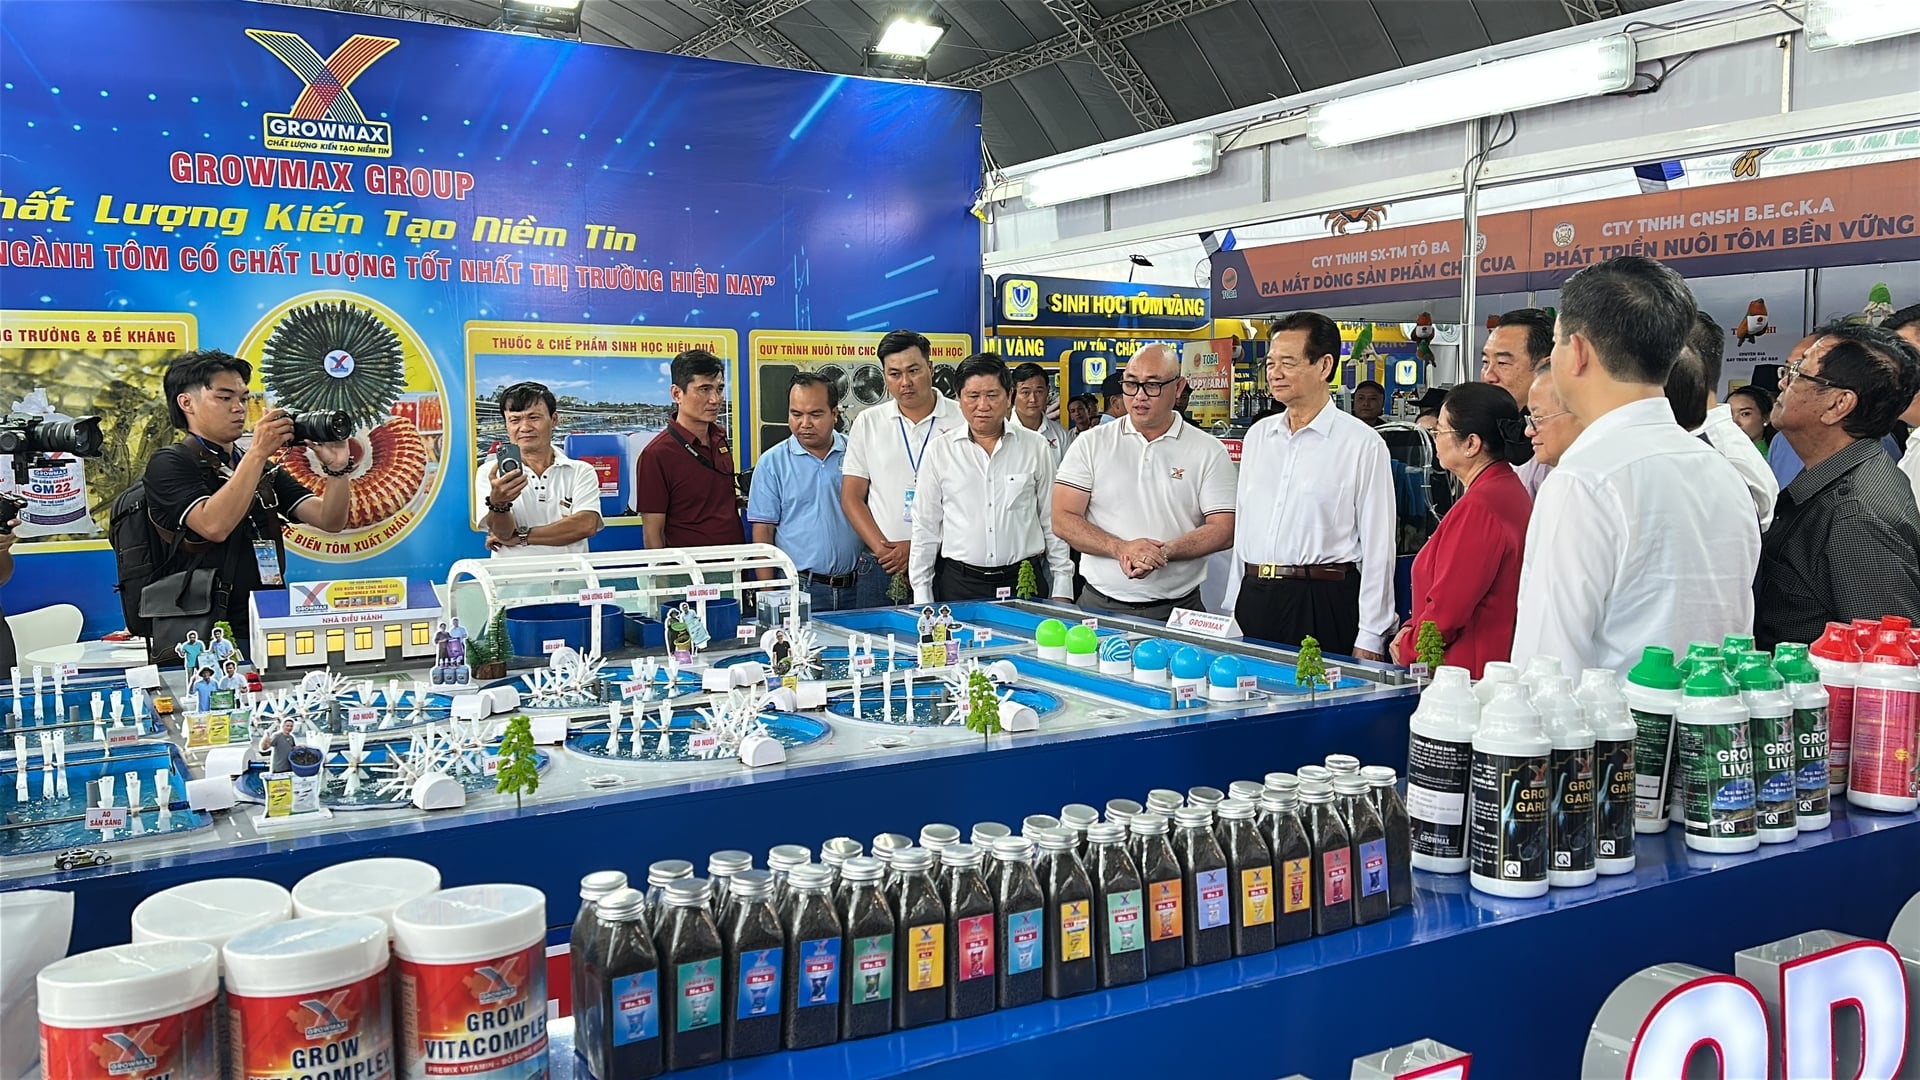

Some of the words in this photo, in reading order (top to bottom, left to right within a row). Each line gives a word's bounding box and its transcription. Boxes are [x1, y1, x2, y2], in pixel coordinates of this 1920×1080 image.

[534, 5, 552, 14] LED
[269, 119, 385, 142] GROWMAX
[267, 138, 289, 148] CHẤT
[290, 140, 317, 149] LƯỢNG
[320, 141, 338, 150] KIẾN
[339, 145, 355, 153] TẠO
[357, 145, 375, 154] NIỀM
[170, 151, 354, 192] GROWMAX
[364, 165, 475, 200] GROUP
[0, 187, 75, 222] hất
[95, 196, 249, 236] Lượng
[263, 202, 364, 236] Kiến
[384, 210, 457, 243] Tạo
[472, 215, 568, 248] Niềm
[584, 224, 638, 252] Tin
[1602, 221, 1632, 238] CTY
[1637, 214, 1685, 233] TNHH
[1690, 208, 1739, 226] CNSH
[1744, 197, 1835, 220] B.E.C.K.A
[1544, 246, 1593, 268] PHÁT
[1664, 231, 1718, 257] NUÔI
[1722, 226, 1775, 250] TÔM
[1782, 218, 1832, 246] BỀN
[1839, 212, 1915, 240] VỮNG
[1312, 254, 1332, 268] CTY
[1336, 250, 1366, 266] TNHH
[1370, 246, 1407, 262] SX-TM
[1411, 240, 1428, 257] TÔ
[1431, 240, 1450, 255] BA
[104, 241, 170, 272] TÔM
[180, 244, 218, 273] CÓ
[228, 242, 302, 276] CHẤT
[310, 252, 396, 284] LƯỢNG
[406, 250, 452, 282] TỐT
[460, 254, 522, 286] NHẤT
[530, 263, 568, 292] THỊ
[576, 264, 664, 292] TRƯỜNG
[670, 267, 718, 298] HIỆN
[1261, 280, 1278, 296] RA
[1282, 273, 1309, 292] MẮT
[1313, 270, 1354, 289] DÒNG
[1356, 264, 1386, 286] SẢN
[1390, 259, 1437, 282] PHẨM
[1440, 260, 1462, 277] CH
[1480, 255, 1516, 273] CUA
[1222, 290, 1238, 299] TOBA
[1051, 292, 1089, 313] SINH
[1093, 295, 1126, 318] HỌC
[1130, 292, 1164, 315] TÔM
[1165, 293, 1205, 316] VÀNG
[0, 329, 12, 343] G
[18, 326, 80, 343] TRƯỞNG
[86, 330, 97, 343] &
[102, 326, 122, 343] ĐỀ
[128, 328, 176, 344] KHÁNG
[492, 335, 532, 350] THUỐC
[537, 338, 544, 349] &
[550, 336, 572, 350] CHẾ
[576, 336, 608, 352] PHẨM
[612, 341, 637, 352] SINH
[641, 341, 662, 354] HỌC
[759, 345, 779, 356] QUY
[781, 342, 809, 355] TRÌNH
[812, 343, 833, 356] NUÔI
[836, 343, 855, 356] TÔM
[930, 347, 943, 356] INH
[946, 346, 963, 358] HỌC
[1006, 336, 1044, 356] VÀNG
[1203, 353, 1218, 365] TOBA
[32, 482, 71, 494] GM22
[280, 525, 298, 539] HẾ
[294, 533, 322, 551] BIẾN
[326, 541, 350, 554] TÔM
[354, 534, 383, 552] XUẤT
[384, 514, 410, 539] KHẨU
[341, 614, 358, 622] ĐIỀU
[361, 613, 383, 621] HÀNH
[1188, 618, 1224, 631] GROWMAX
[702, 737, 714, 746] NUÔI
[1799, 732, 1828, 744] GRO
[1764, 742, 1794, 755] GRO
[1803, 746, 1828, 758] LIVE
[488, 762, 495, 770] AO
[1722, 761, 1753, 777] LIVE
[1768, 756, 1795, 770] LIVE
[1615, 771, 1634, 781] GRO
[1569, 780, 1594, 791] GRO
[1610, 783, 1634, 794] GAR
[1564, 792, 1594, 804] GARL
[1516, 802, 1546, 813] GARL
[1420, 834, 1450, 845] GROWMAX
[466, 1000, 526, 1032] GROW
[423, 1020, 548, 1060] VITACOMPLE
[292, 1036, 360, 1070] GROW
[427, 1064, 459, 1075] PREMIX
[462, 1061, 494, 1073] VITAMIN
